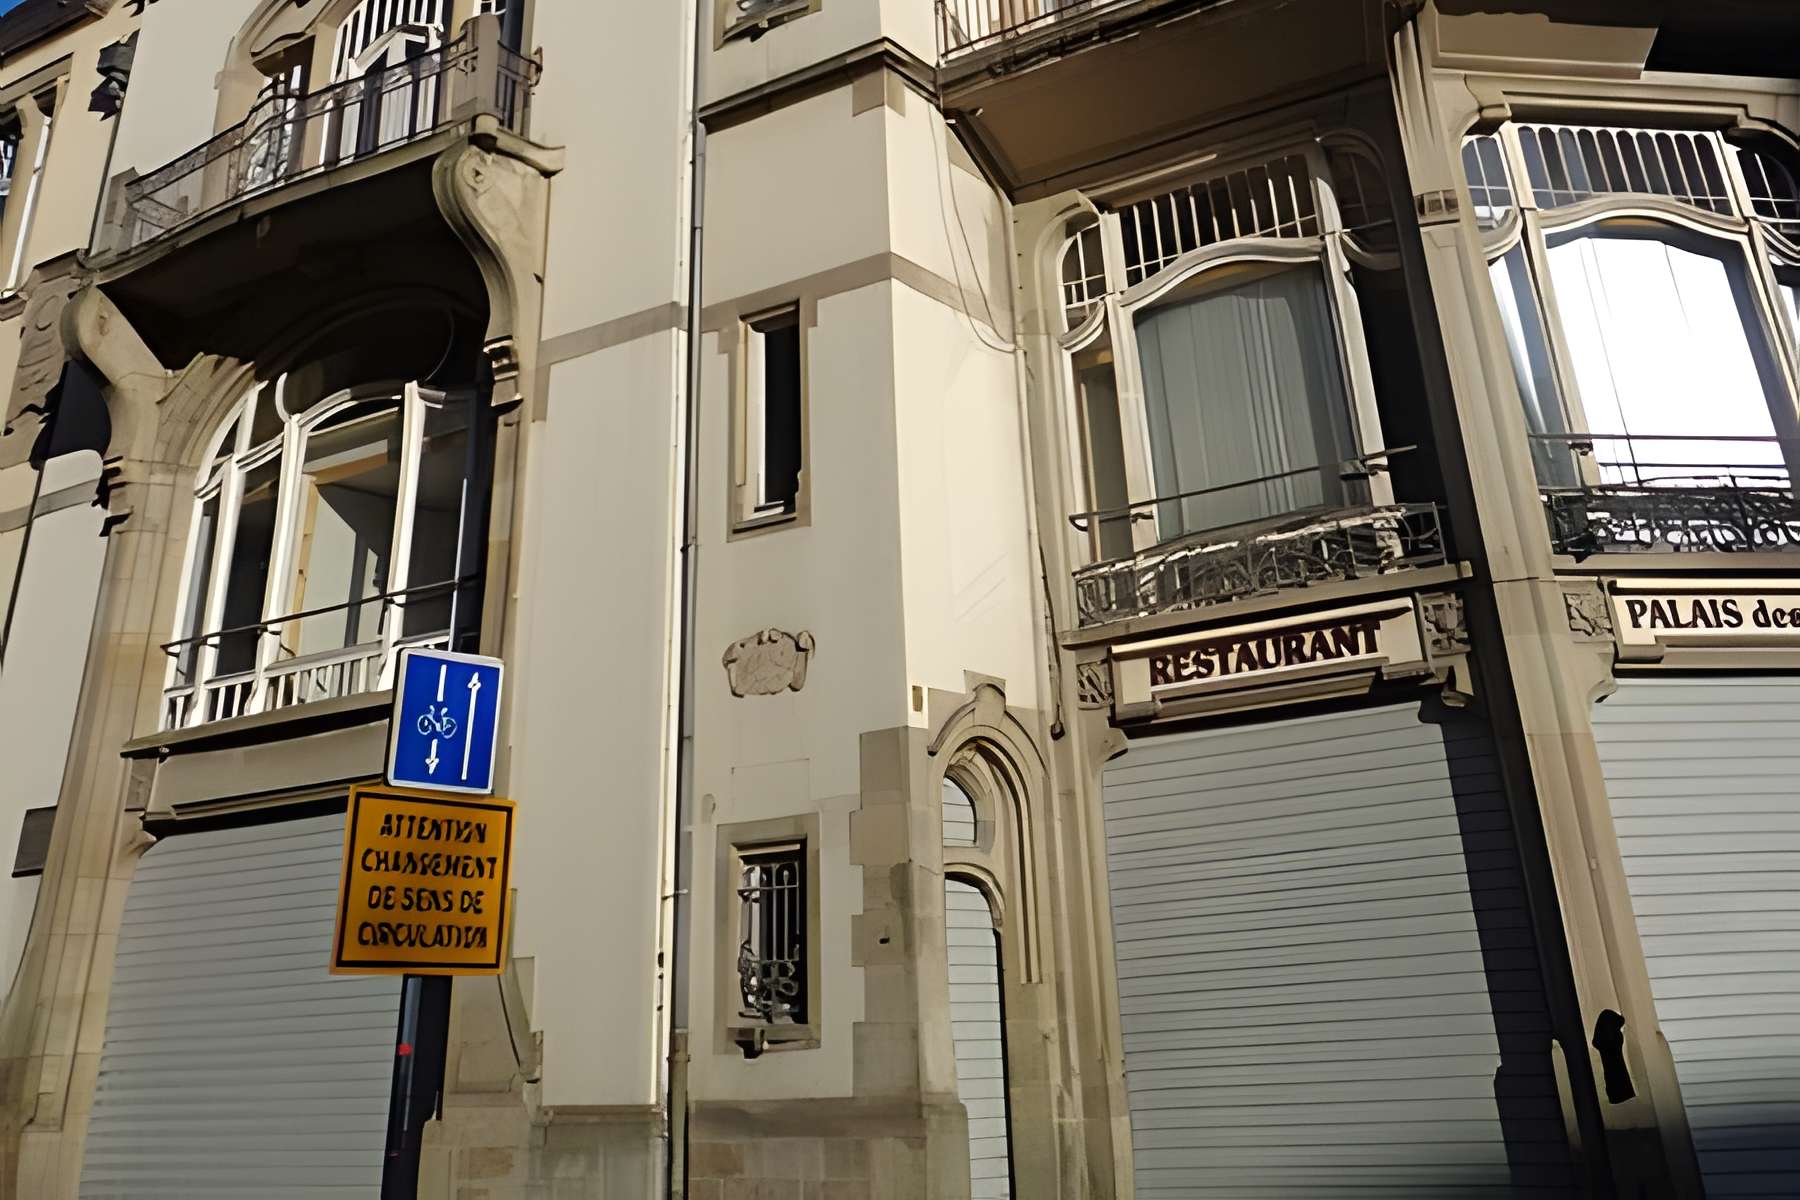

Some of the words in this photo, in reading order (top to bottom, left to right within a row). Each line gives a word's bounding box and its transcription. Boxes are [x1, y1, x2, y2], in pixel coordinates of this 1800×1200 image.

[1625, 599, 1743, 628] PALAIS
[1150, 621, 1381, 686] RESTAURANT
[380, 813, 487, 843] ATTENTION
[368, 885, 396, 910] DE
[401, 887, 454, 912] SENS
[460, 890, 484, 914] DE
